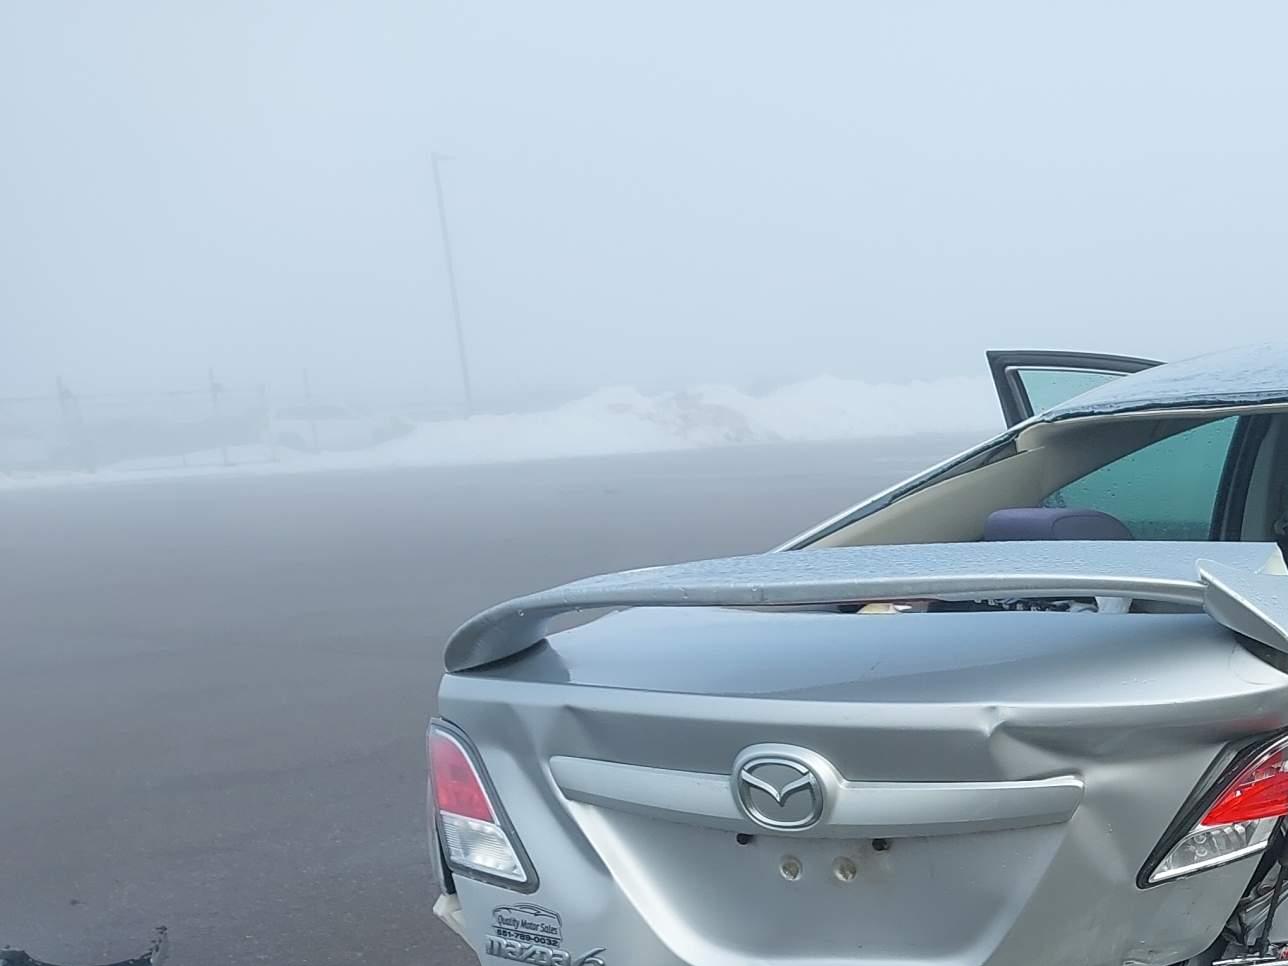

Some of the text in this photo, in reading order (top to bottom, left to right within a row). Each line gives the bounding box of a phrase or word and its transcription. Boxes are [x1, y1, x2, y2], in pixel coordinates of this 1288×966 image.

[498, 915, 558, 935] Quality Motor Sales
